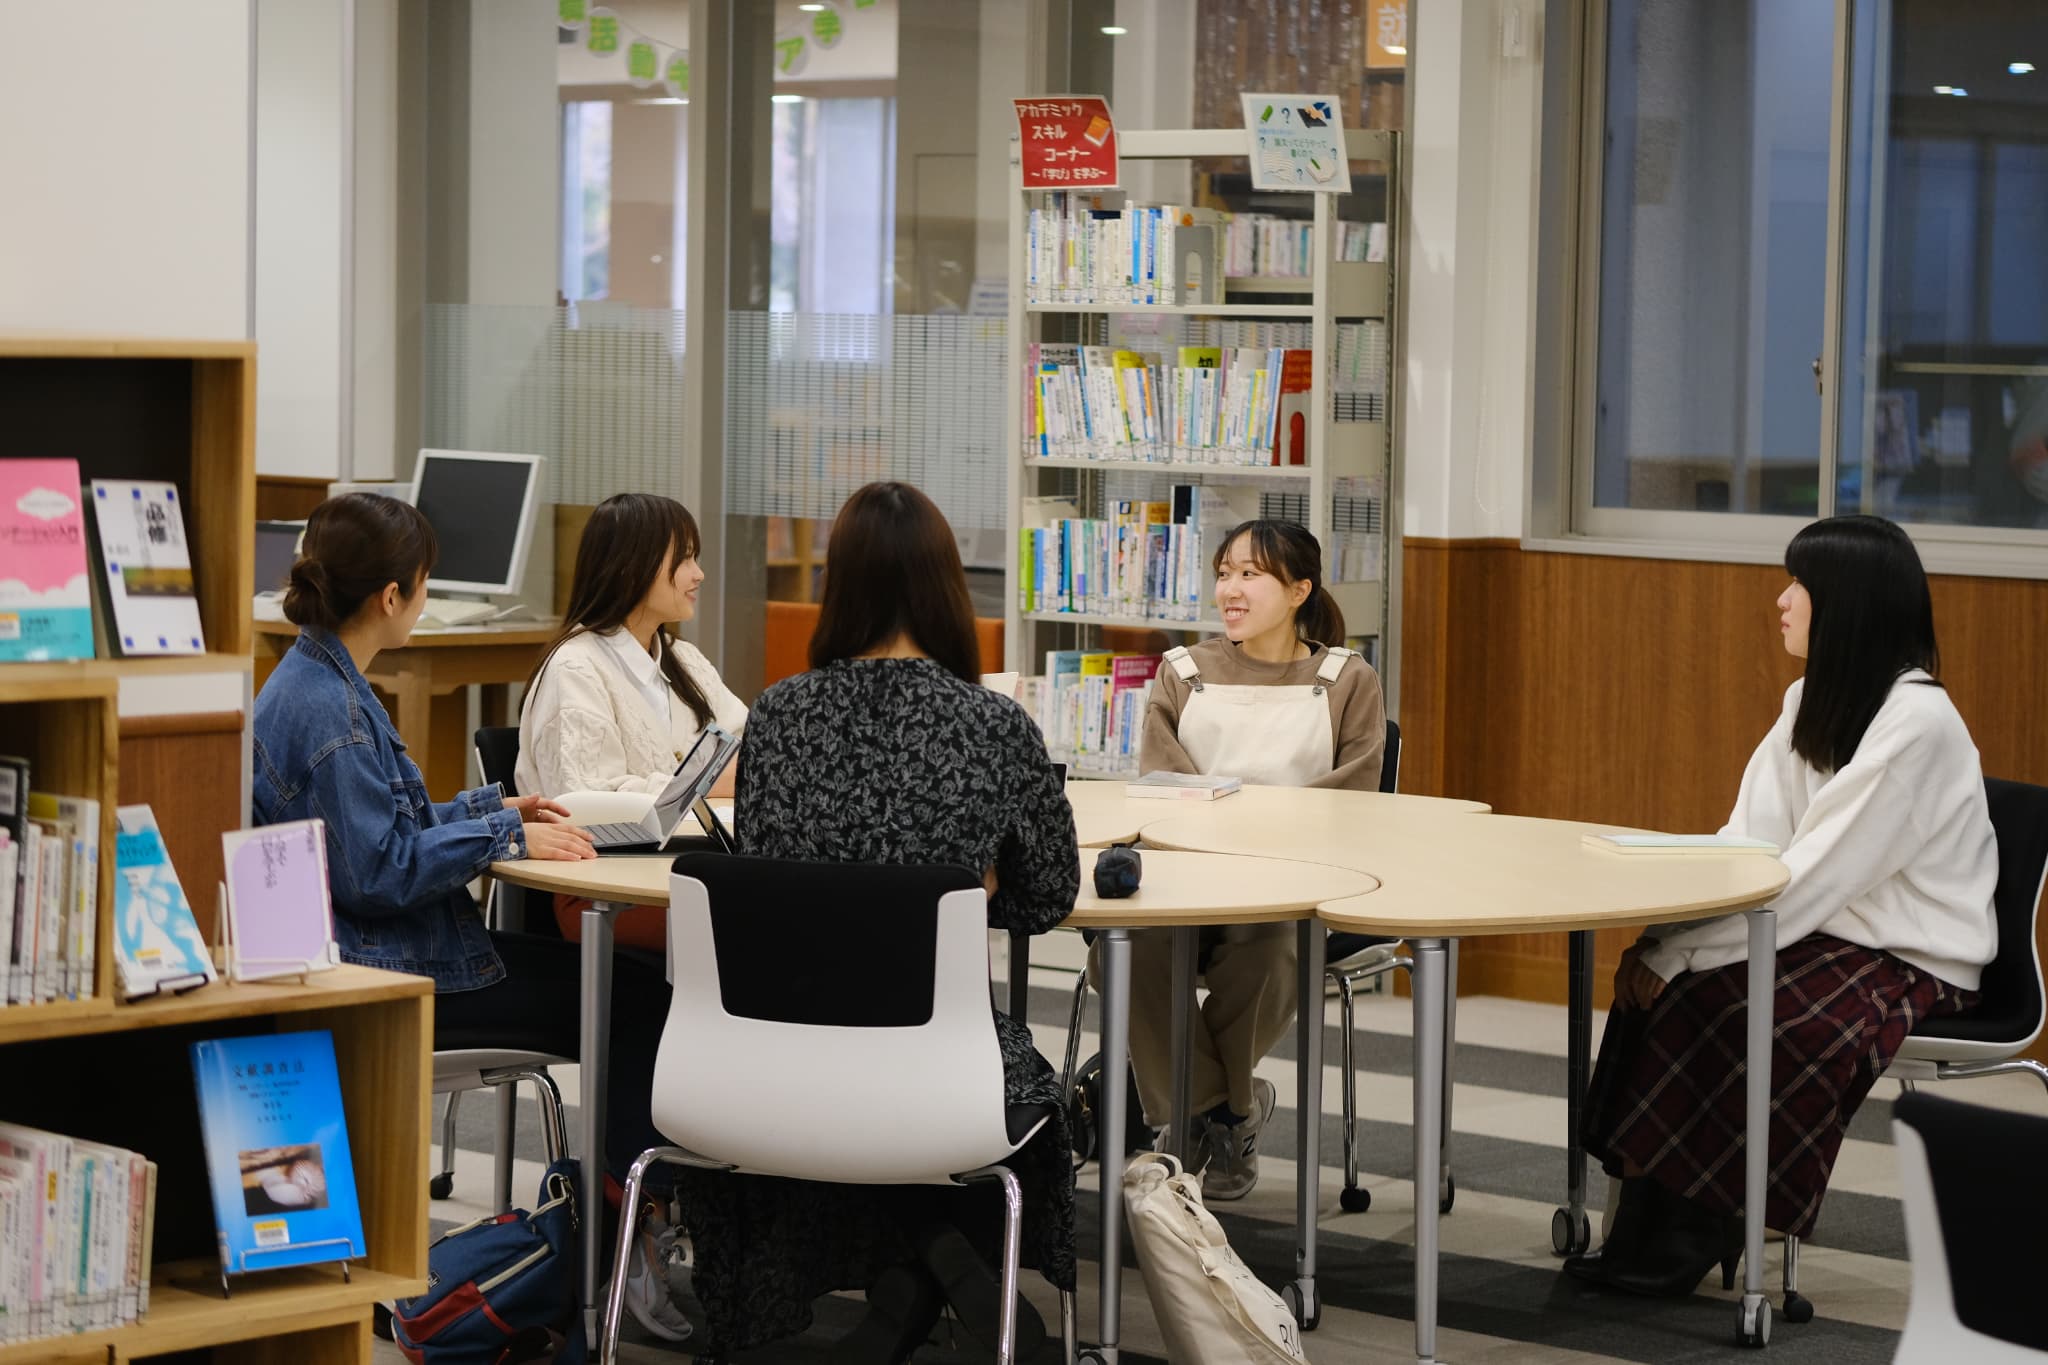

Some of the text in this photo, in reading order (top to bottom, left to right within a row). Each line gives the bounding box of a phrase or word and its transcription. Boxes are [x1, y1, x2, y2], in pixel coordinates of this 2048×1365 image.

[1015, 103, 1083, 118] アカデミック
[1031, 124, 1068, 140] スキル
[1043, 146, 1092, 162] コーナー
